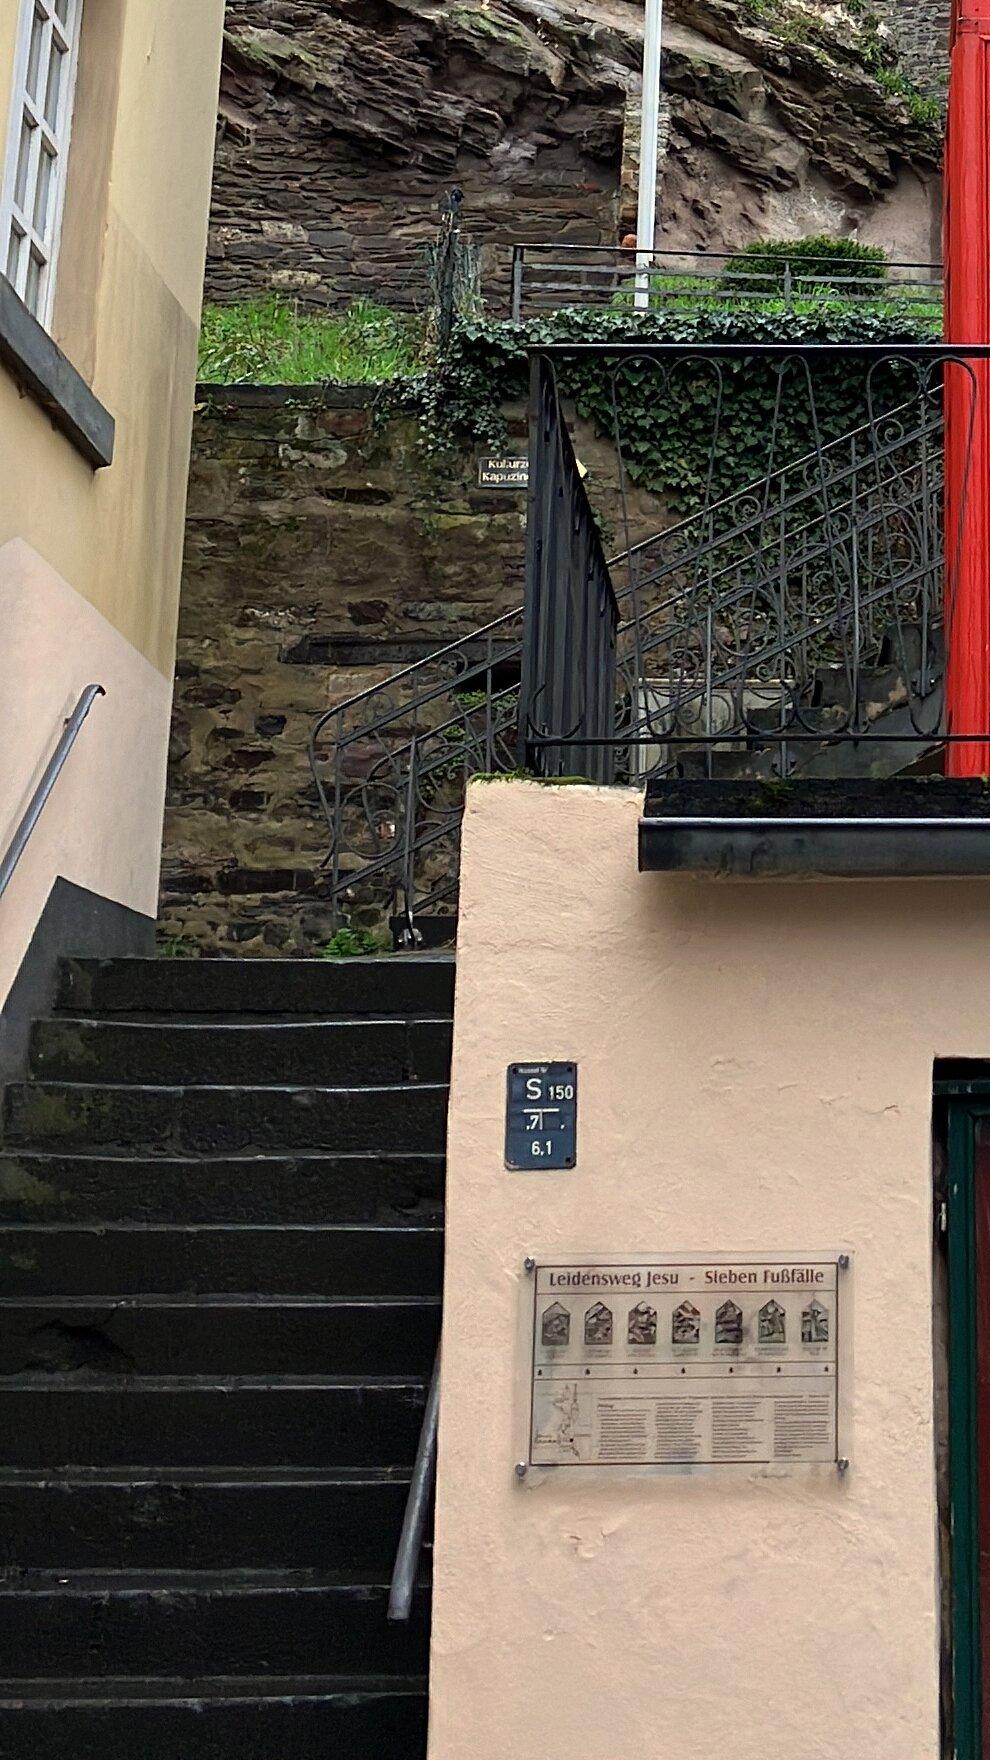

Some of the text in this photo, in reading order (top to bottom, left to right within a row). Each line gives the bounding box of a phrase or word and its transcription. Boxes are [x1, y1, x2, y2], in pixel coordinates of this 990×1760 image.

[526, 1078, 574, 1100] S 150
[549, 1271, 642, 1288] Leidensweg
[645, 1271, 679, 1288] Jesu
[704, 1270, 757, 1285] Sieben
[763, 1269, 824, 1284] Fußfälle
